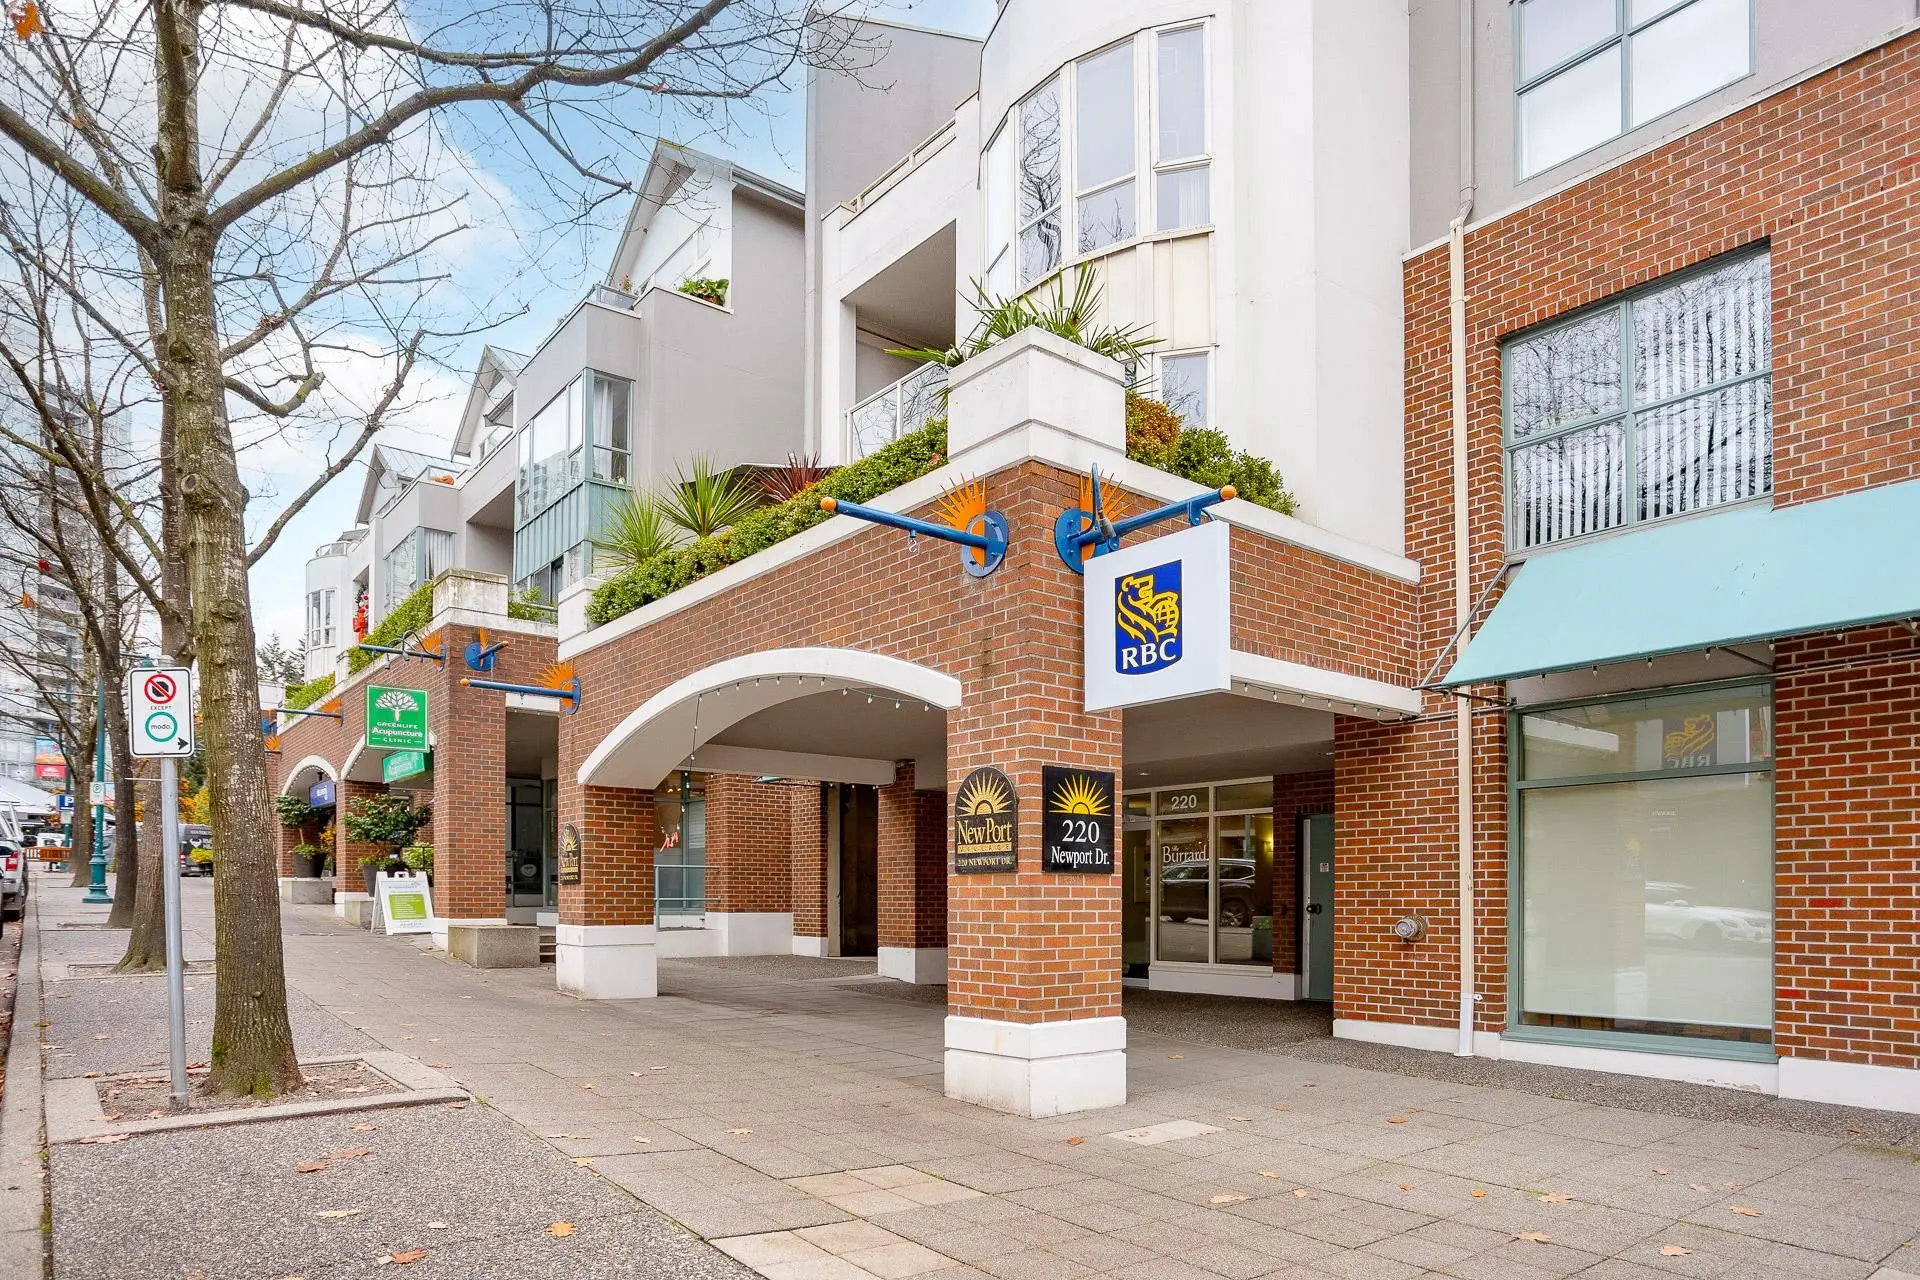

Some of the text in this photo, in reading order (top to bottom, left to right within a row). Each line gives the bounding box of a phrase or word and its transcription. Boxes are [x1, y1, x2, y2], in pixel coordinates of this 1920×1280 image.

[1122, 638, 1176, 670] RBC
[372, 727, 422, 738] Acupuncture
[376, 722, 418, 730] GREENLIFE
[64, 796, 74, 806] P
[1171, 794, 1197, 810] 220
[1062, 820, 1100, 844] 220
[959, 844, 1009, 852] VILLAGE
[1162, 844, 1208, 864] Burrard
[969, 857, 999, 866] NEWPORT
[1051, 846, 1110, 868] Newport Dr.
